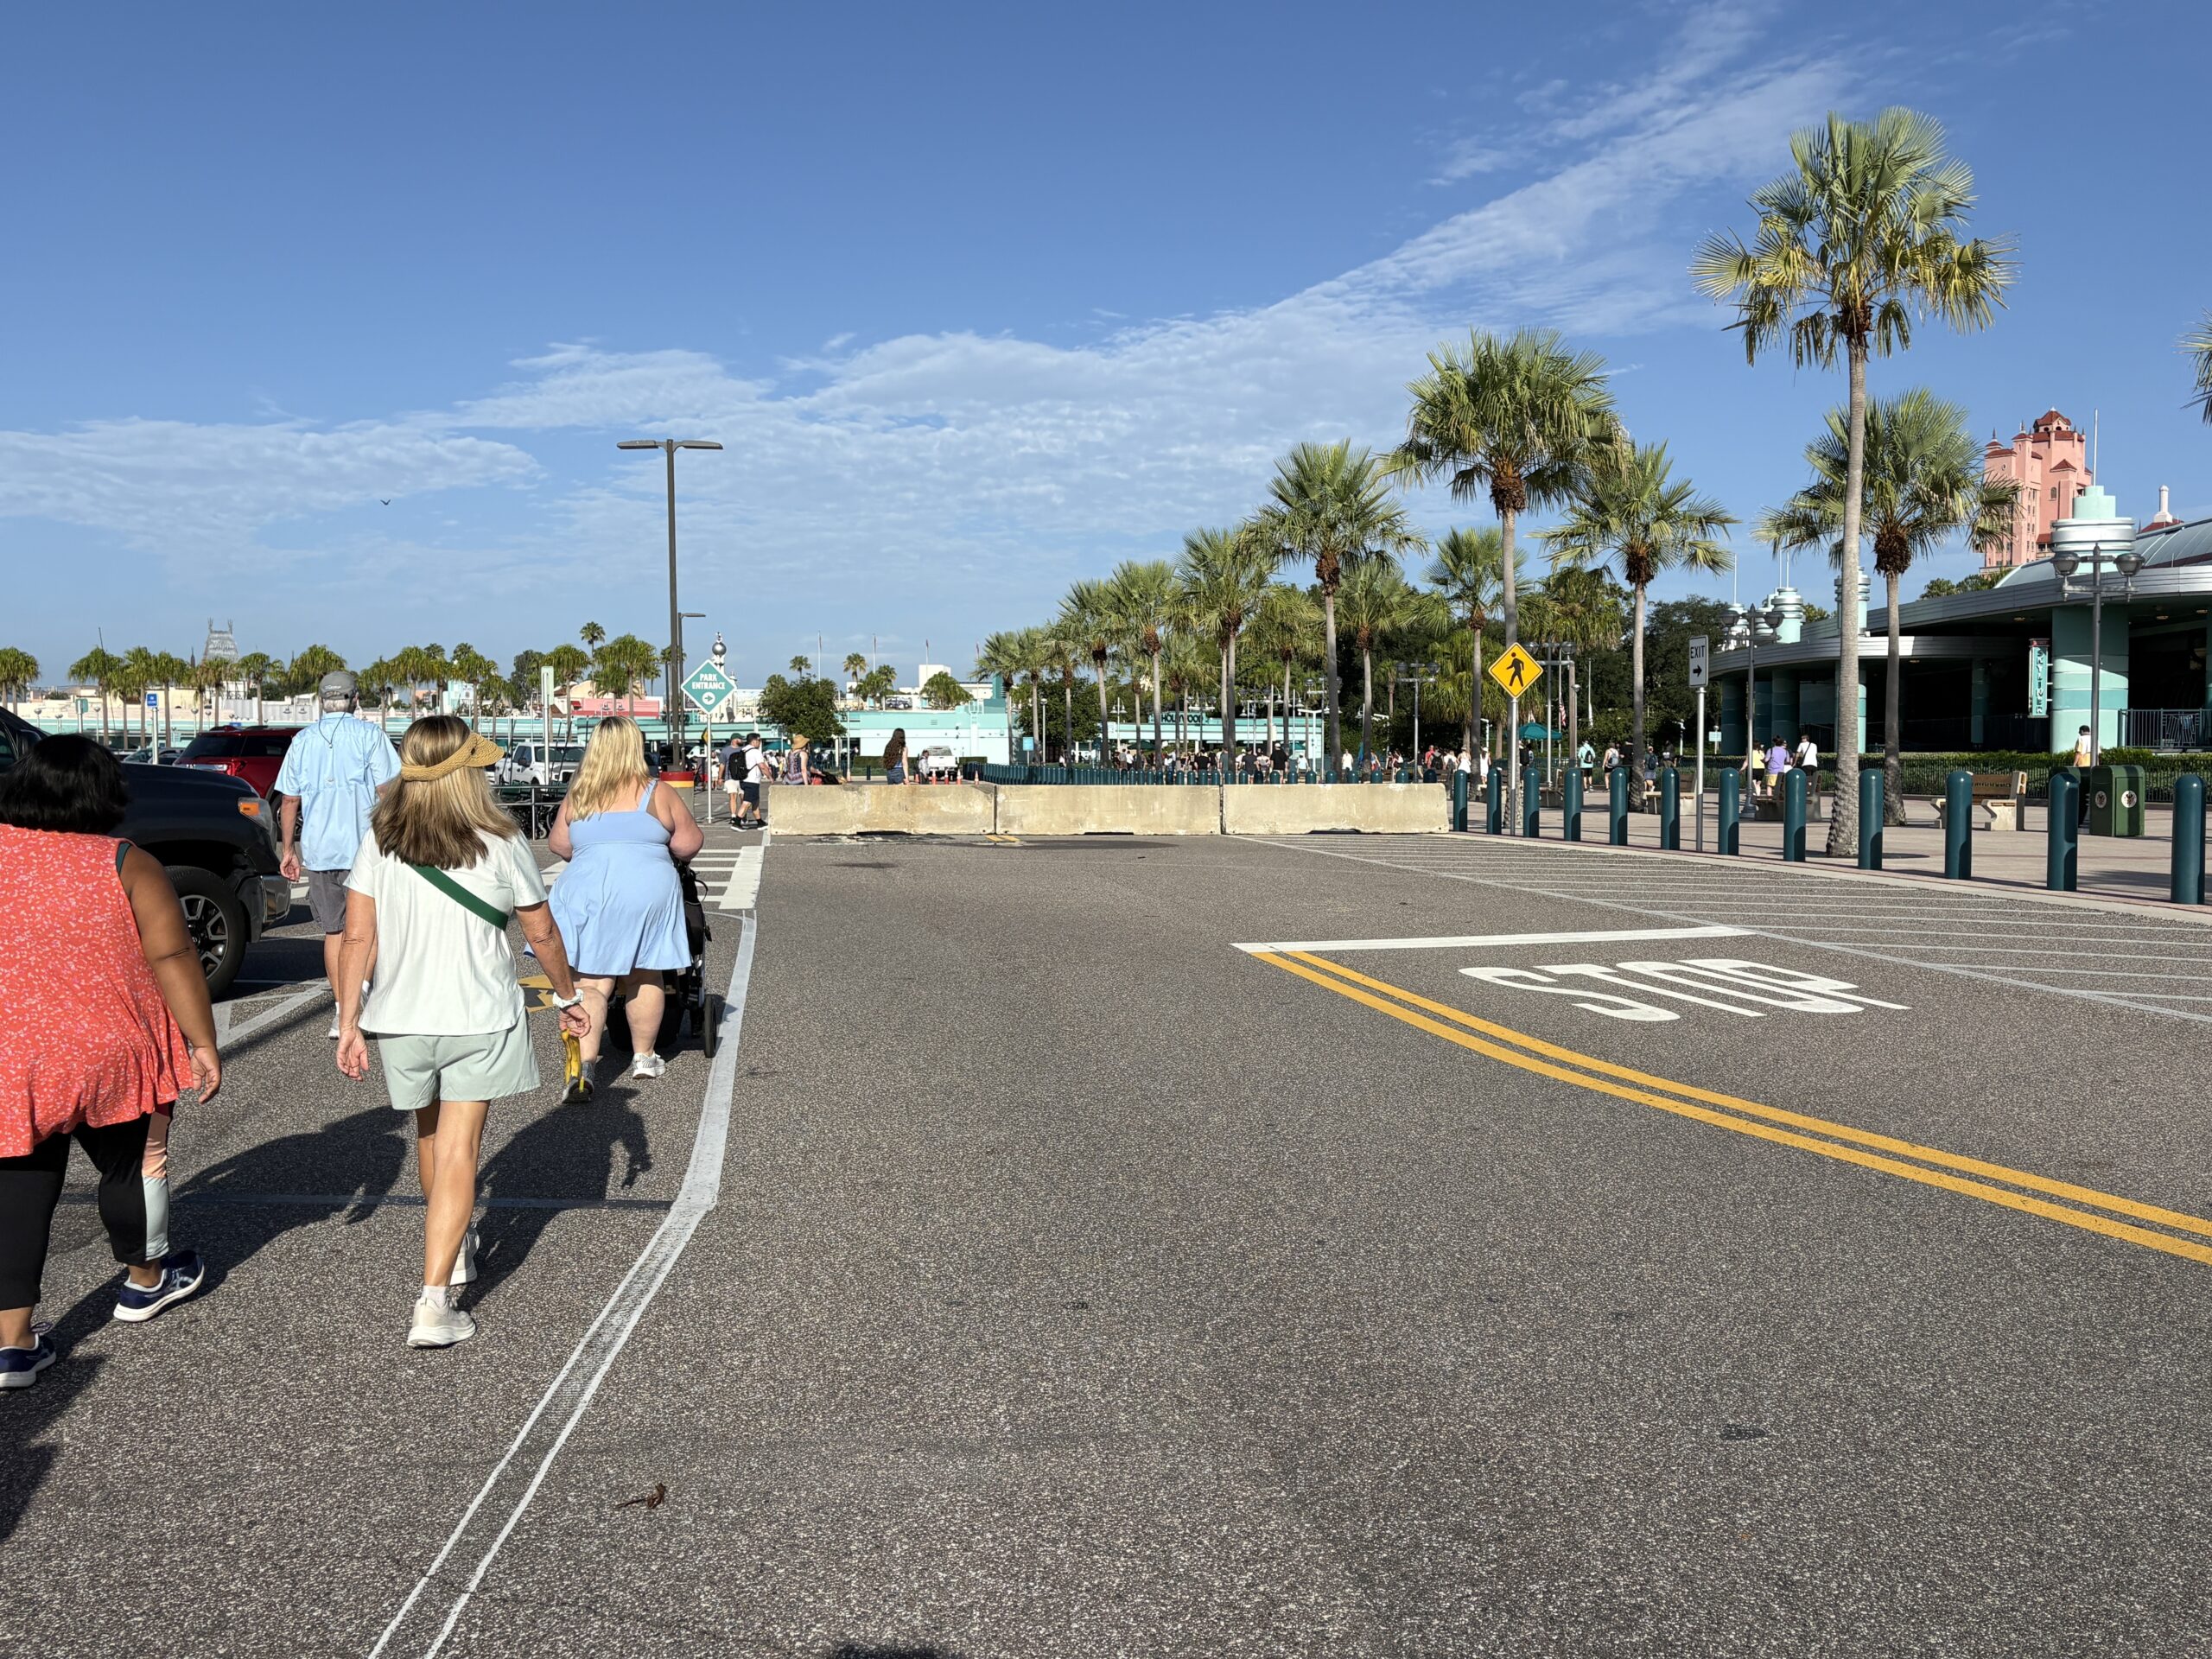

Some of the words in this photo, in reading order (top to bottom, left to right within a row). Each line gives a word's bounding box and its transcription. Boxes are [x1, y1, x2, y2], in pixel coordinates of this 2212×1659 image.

[1690, 645, 1706, 659] EXIT
[699, 673, 717, 682] PARK
[691, 681, 726, 690] ENTRANCE
[1161, 714, 1204, 723] HOLOOD
[1458, 958, 1912, 1021] STOP
